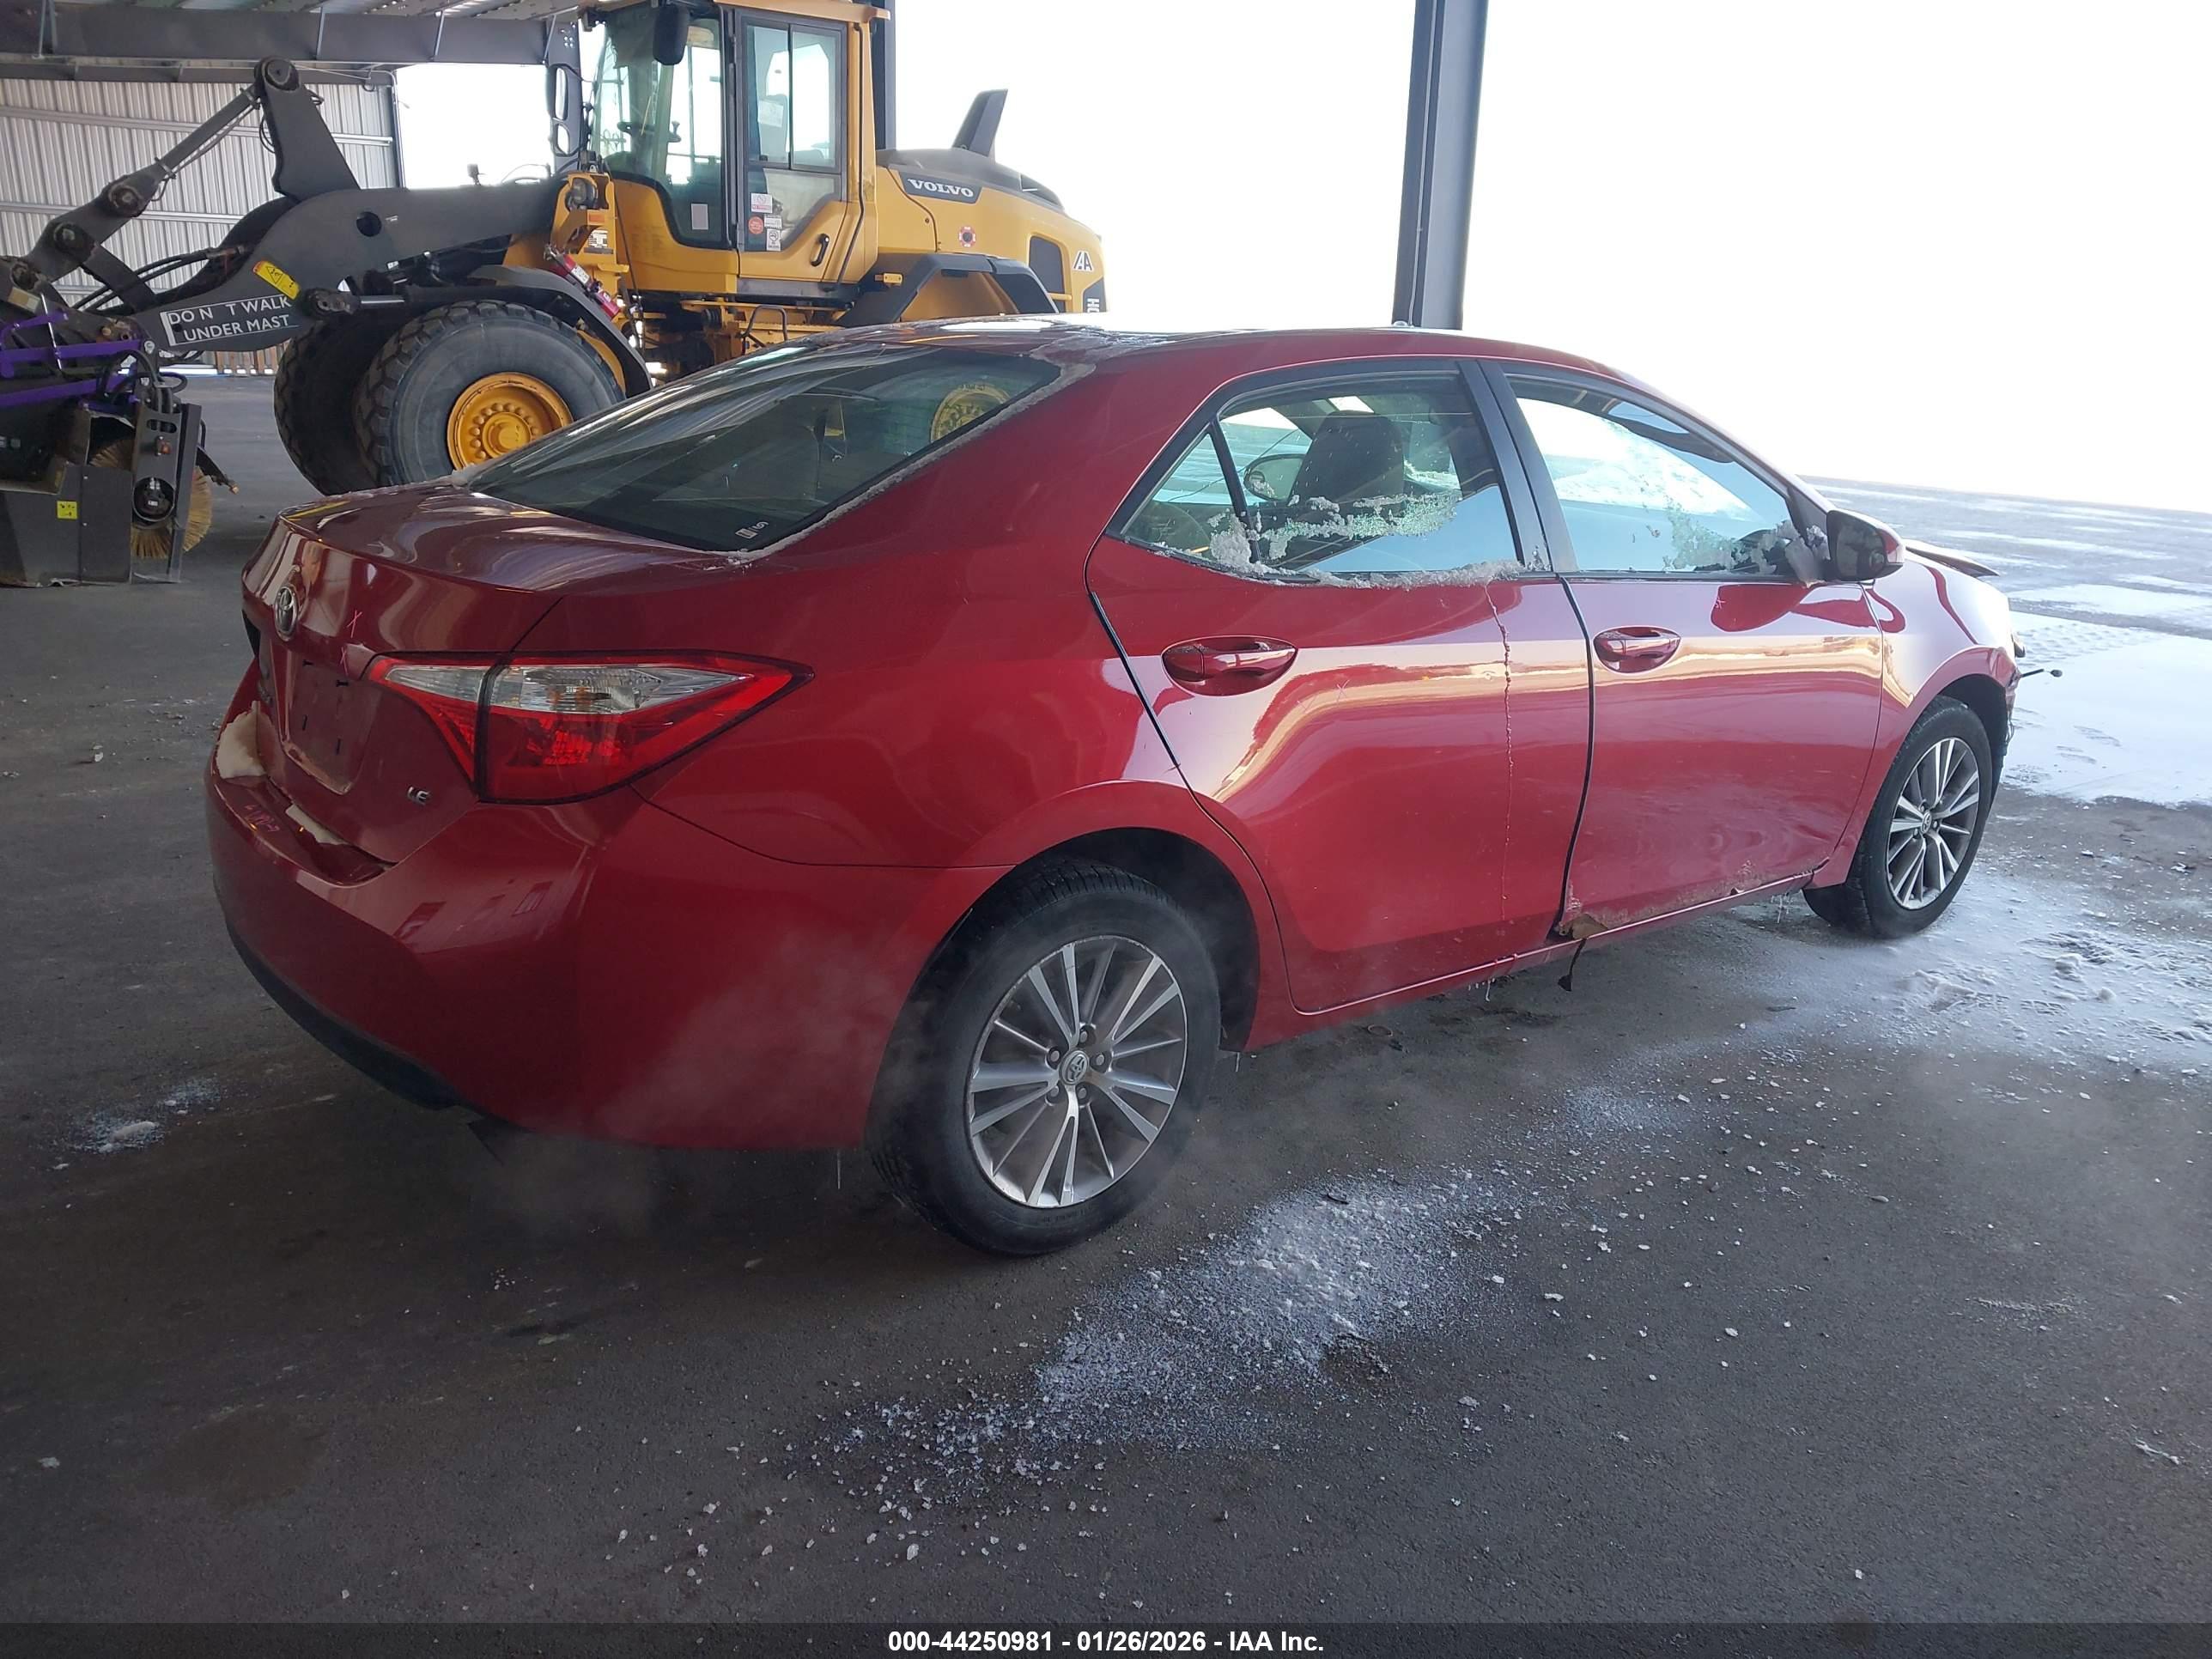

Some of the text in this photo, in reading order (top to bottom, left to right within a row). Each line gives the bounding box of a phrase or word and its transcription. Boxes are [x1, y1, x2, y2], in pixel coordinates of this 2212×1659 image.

[907, 178, 974, 198] VOLVO
[240, 296, 292, 313] WALK
[183, 314, 289, 342] UNDER MAST
